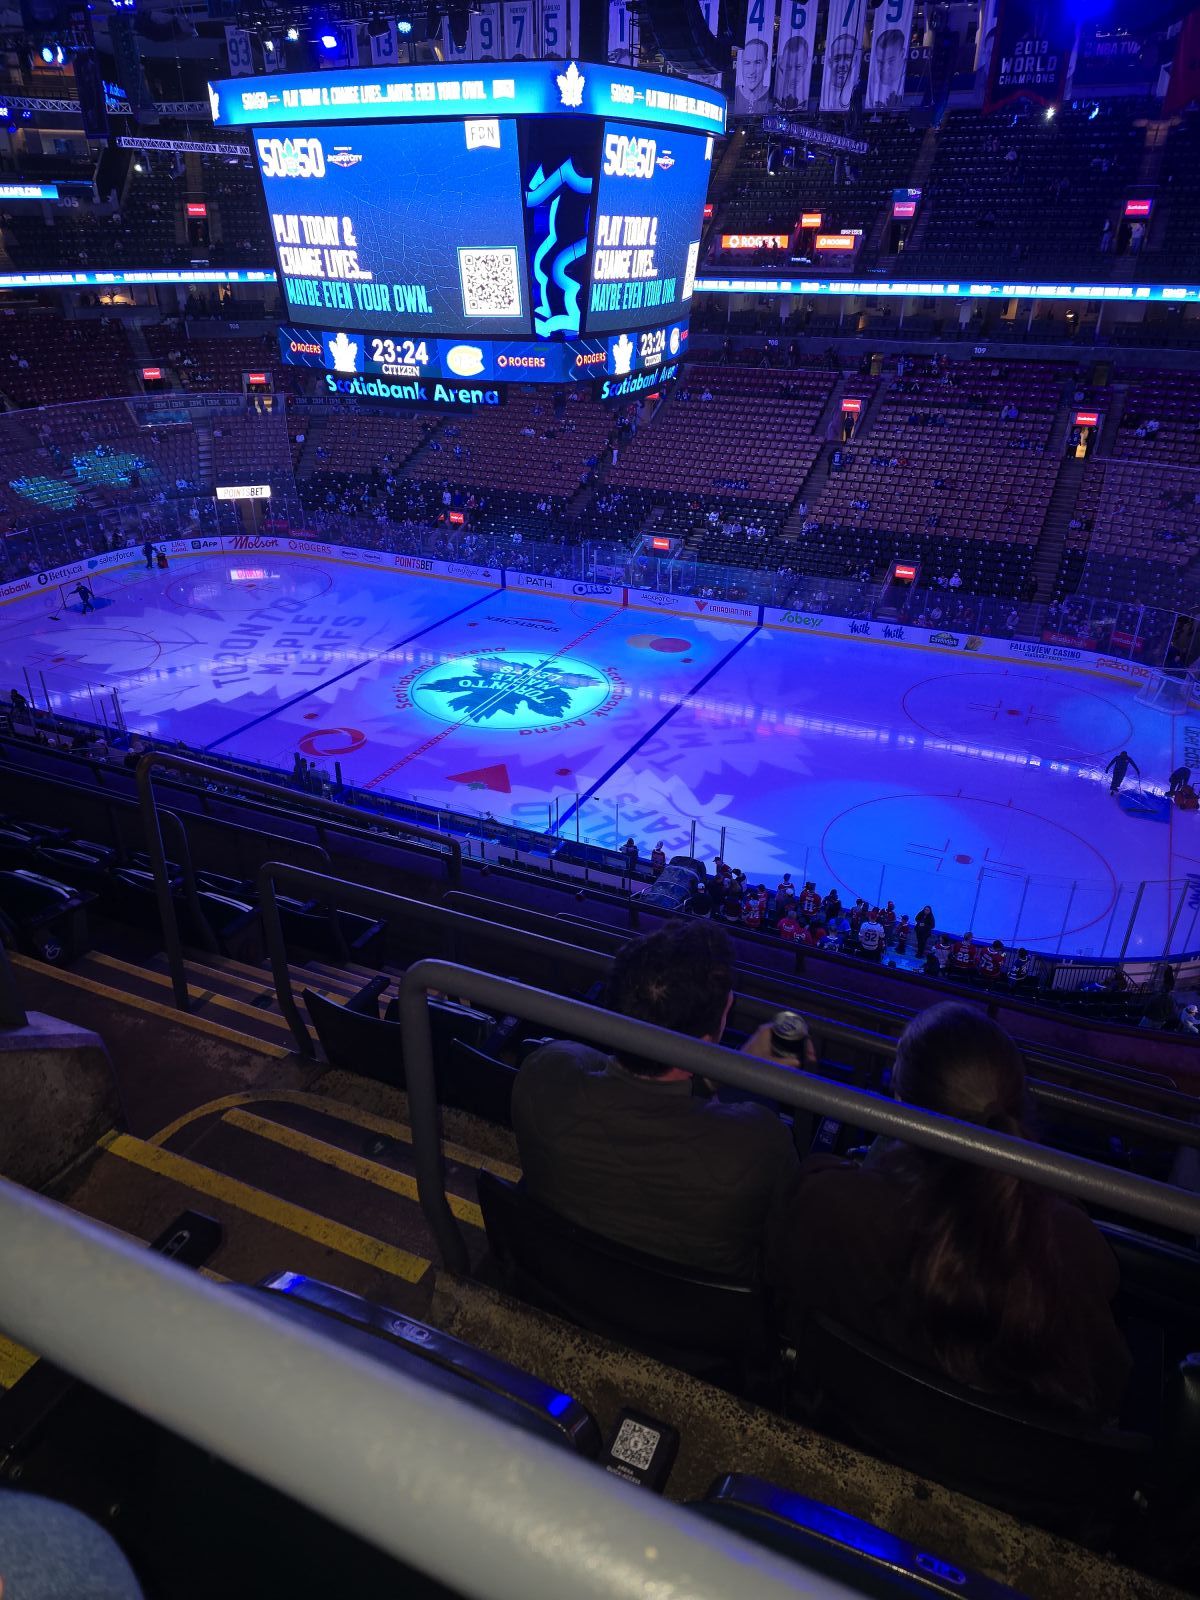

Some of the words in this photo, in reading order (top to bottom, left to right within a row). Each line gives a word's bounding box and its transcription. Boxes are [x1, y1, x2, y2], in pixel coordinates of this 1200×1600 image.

[750, 0, 765, 31] 4
[792, 2, 806, 30] 6
[512, 16, 524, 48] 7
[544, 14, 558, 46] 5
[619, 8, 624, 42] 1
[480, 18, 492, 50] 9
[230, 39, 250, 66] 93
[376, 36, 392, 56] 13
[1002, 56, 1057, 74] WORLD
[999, 74, 1055, 85] CHAMPIONS
[470, 127, 495, 141] FDN
[57, 196, 79, 207] 05
[273, 214, 300, 244] PLAY
[300, 216, 340, 246] TODAY
[343, 217, 357, 246] &
[597, 215, 623, 246] PLAY
[622, 216, 650, 246] TODAY
[650, 217, 658, 246] &
[279, 247, 325, 278] CHANGE
[594, 250, 632, 280] CHANGE
[285, 278, 322, 307] MAYBE
[322, 281, 354, 310] EVEN
[354, 283, 392, 312] YOUR
[394, 285, 432, 314] OWN.
[591, 283, 622, 312] MAYBE
[622, 282, 644, 310] EVEN
[644, 280, 662, 308] YOUR
[297, 344, 322, 354] ROGERS
[372, 338, 429, 365] 23:24
[641, 330, 666, 356] 23:24
[508, 356, 546, 368] ROGERS
[584, 352, 606, 364] ROGERS
[382, 364, 420, 377] CITIZEN
[326, 374, 428, 400] Scotiabank
[434, 384, 498, 404] Arena
[224, 487, 263, 497] POINTSBET
[229, 536, 279, 550] Molson
[299, 543, 332, 554] ROGERS
[100, 550, 134, 565] salesforce
[394, 556, 434, 570] POINTSBET
[49, 565, 83, 582] Betty.ca
[526, 576, 553, 588] PATH
[573, 584, 612, 596] OREO
[710, 606, 739, 615] CANADIAN
[780, 611, 824, 628] Sobeys
[1010, 642, 1052, 655] FALLSVIEW
[1052, 646, 1081, 659] CASINO
[1096, 657, 1129, 672] pizza
[519, 718, 587, 736] Arena
[864, 932, 878, 942] 92
[957, 952, 970, 962] 22
